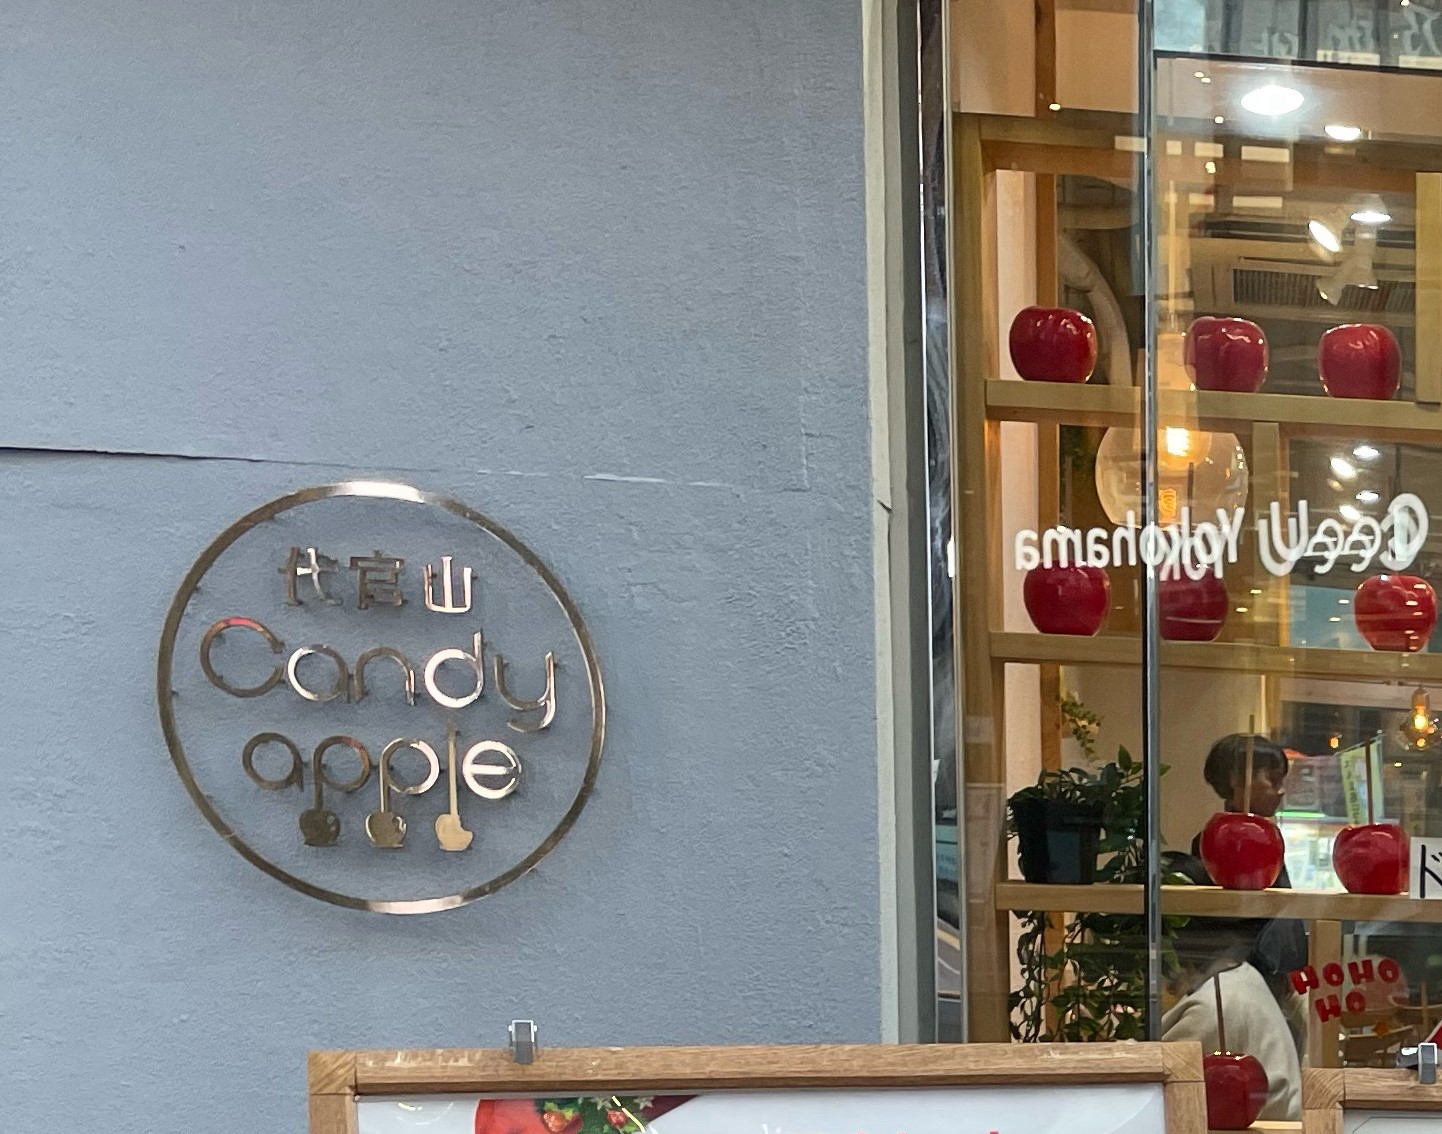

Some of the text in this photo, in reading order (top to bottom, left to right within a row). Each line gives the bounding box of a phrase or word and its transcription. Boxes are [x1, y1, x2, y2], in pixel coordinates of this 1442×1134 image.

[279, 547, 481, 613] 代官山
[200, 617, 558, 733] Candy
[243, 722, 524, 852] apple
[1315, 991, 1366, 1022] HO
